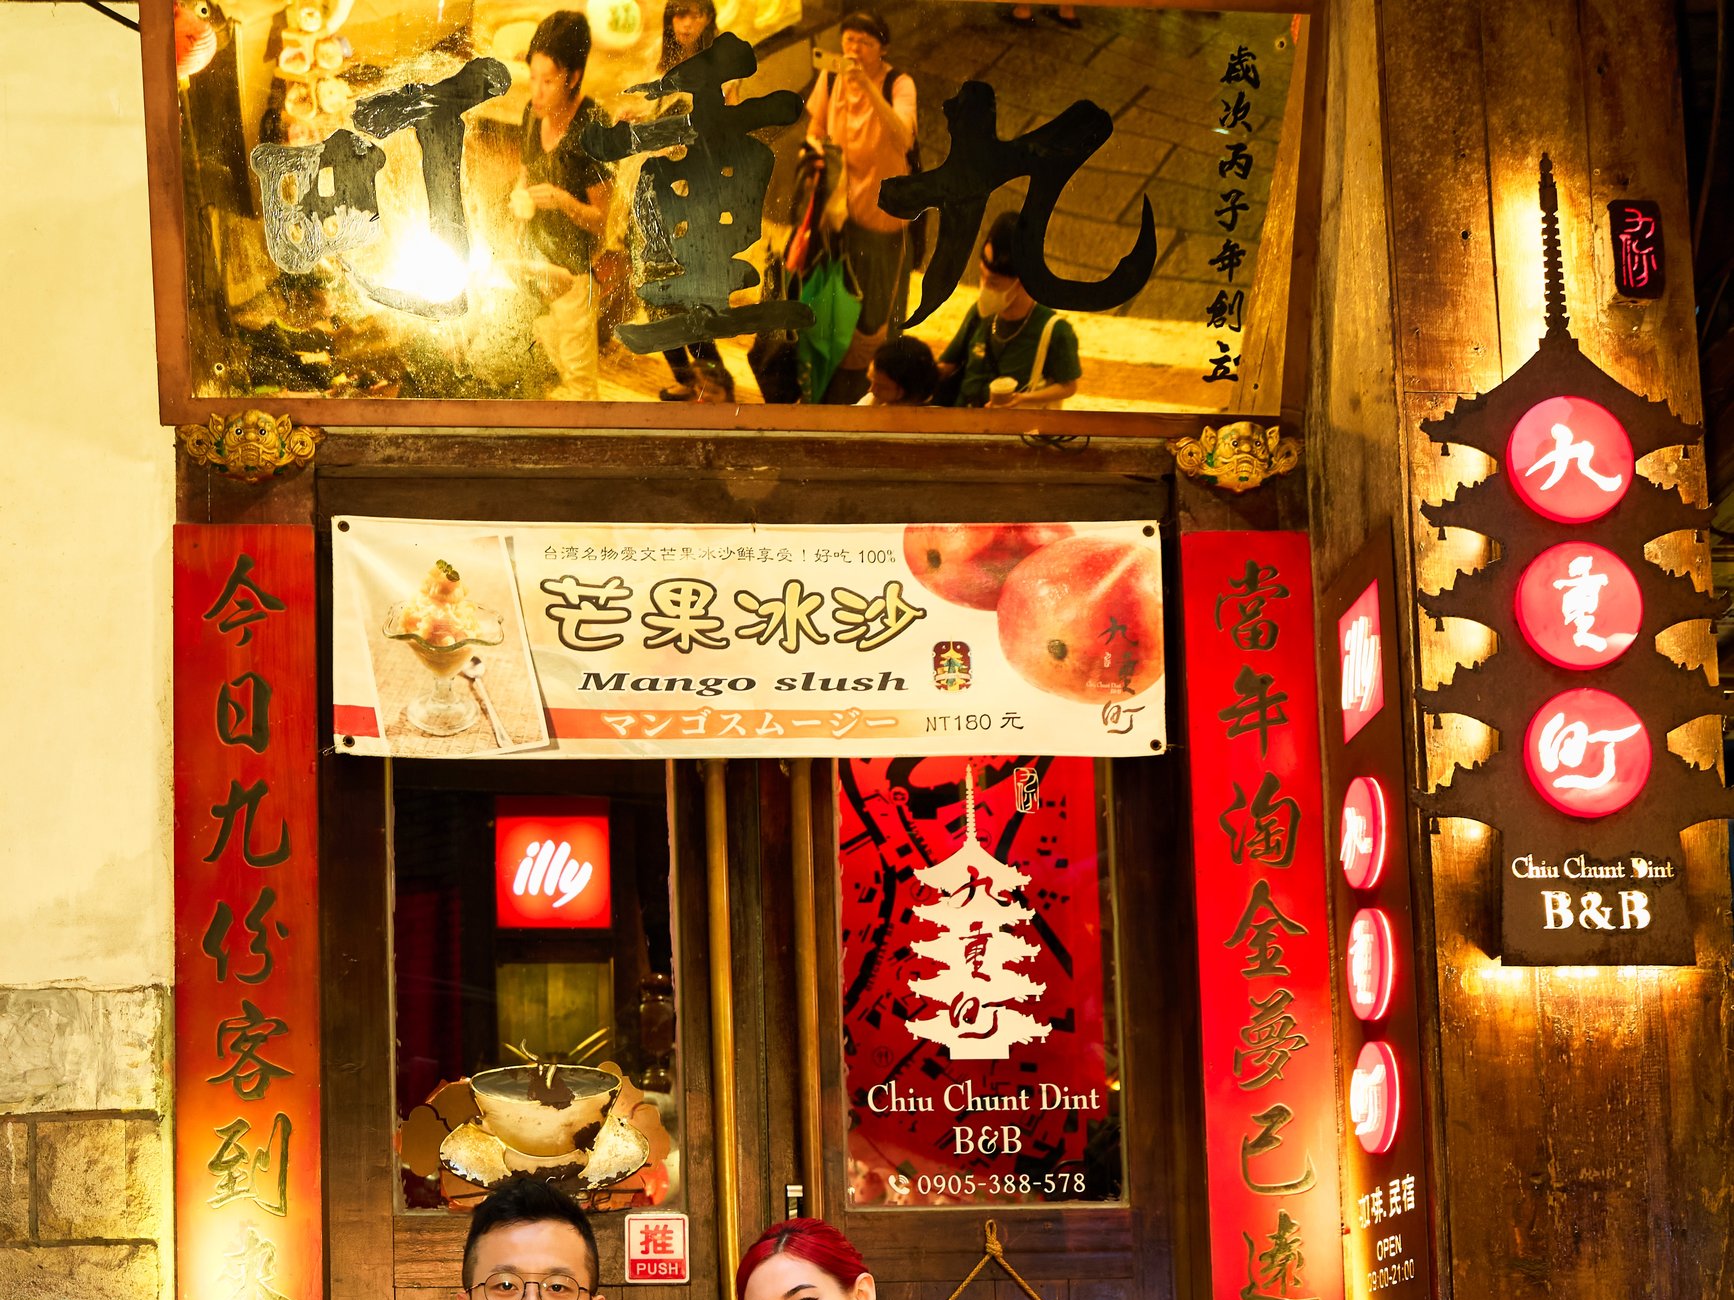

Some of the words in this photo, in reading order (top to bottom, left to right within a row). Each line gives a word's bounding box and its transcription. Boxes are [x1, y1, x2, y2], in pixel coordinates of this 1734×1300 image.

[250, 32, 1157, 354] 九重町
[858, 549, 896, 564] 100%
[540, 575, 927, 654] 芒果冰沙
[1525, 424, 1641, 789] 九重町
[578, 671, 757, 697] Mango
[774, 671, 909, 691] slush
[602, 707, 898, 739] マンゴスムージー
[925, 714, 993, 732] NT180
[1000, 711, 1025, 731] 元
[512, 838, 594, 909] illy
[1511, 853, 1560, 880] Chiu
[1563, 854, 1625, 880] Chunt
[1630, 854, 1675, 880] Dint
[1540, 889, 1652, 931] B&B
[949, 865, 1010, 1040] 九重町
[867, 1079, 935, 1113] Chiu
[943, 1079, 1030, 1112] Chunt
[1038, 1082, 1101, 1111] Dint
[952, 1125, 1023, 1155] B&B
[917, 1173, 1087, 1195] 0905-388-578
[639, 1223, 675, 1255] 推
[1376, 1232, 1403, 1262] OPEN
[636, 1262, 679, 1276] PUSH
[1367, 1258, 1416, 1293] 09:00-21:00
